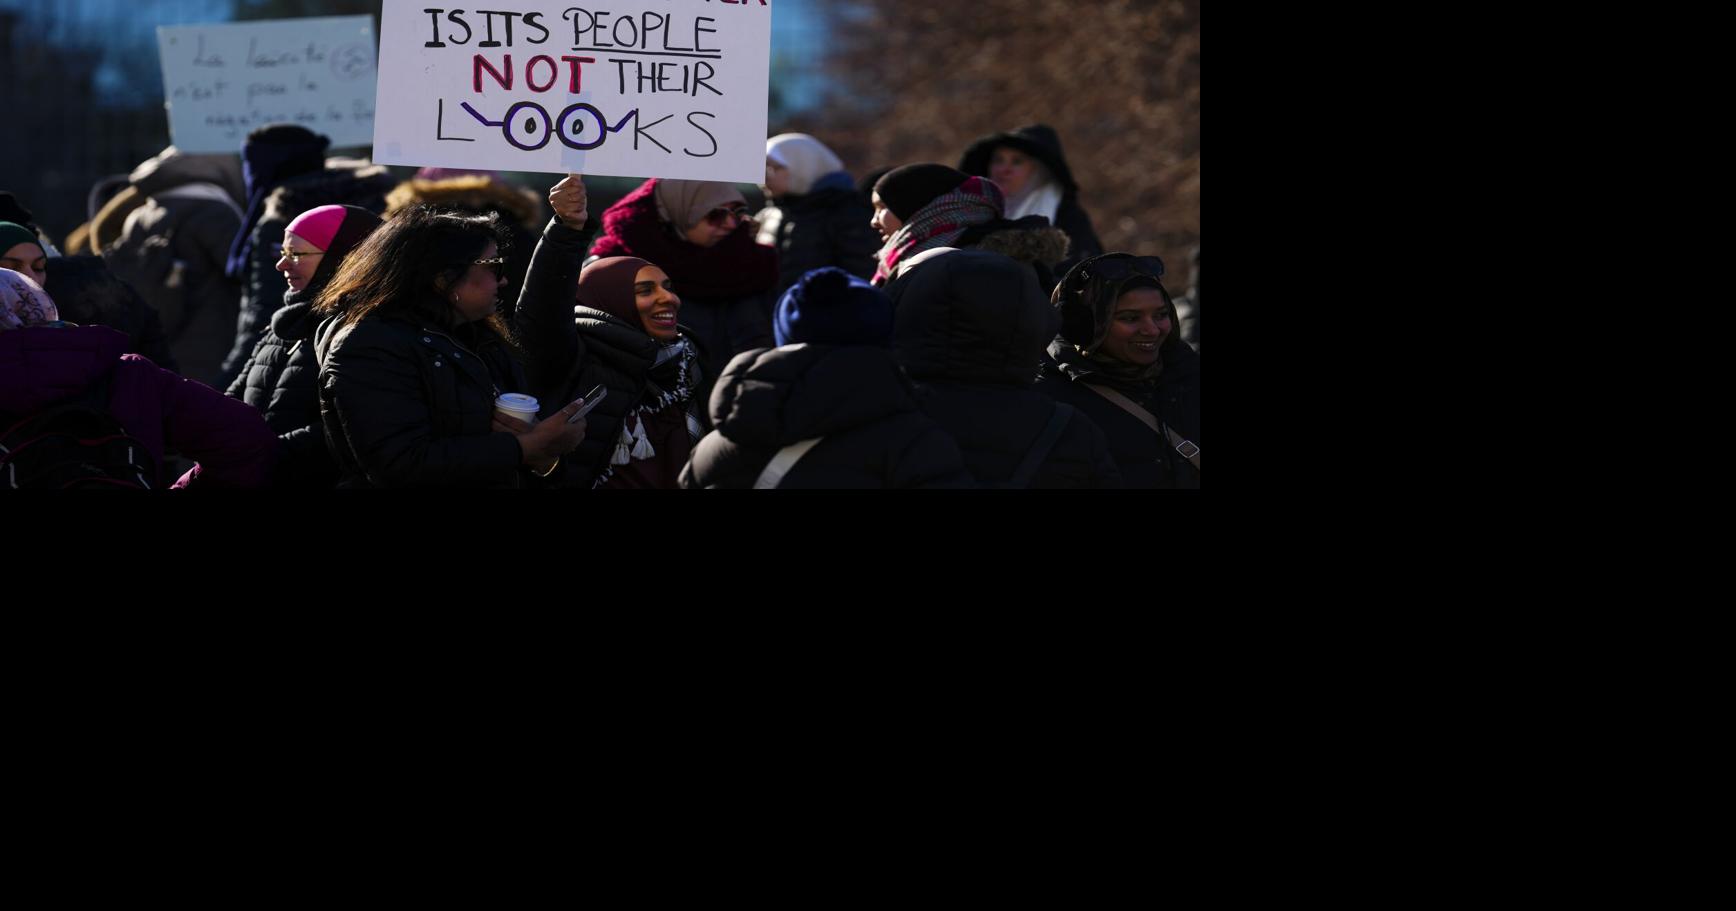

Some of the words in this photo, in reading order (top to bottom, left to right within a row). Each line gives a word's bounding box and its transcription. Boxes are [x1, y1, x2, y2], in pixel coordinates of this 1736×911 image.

[424, 8, 472, 48] IS
[476, 10, 549, 47] ITS
[562, 7, 721, 52] PEOPLE
[473, 54, 595, 94] NOT
[608, 58, 723, 96] THEIR
[437, 98, 718, 157] LOOKS
